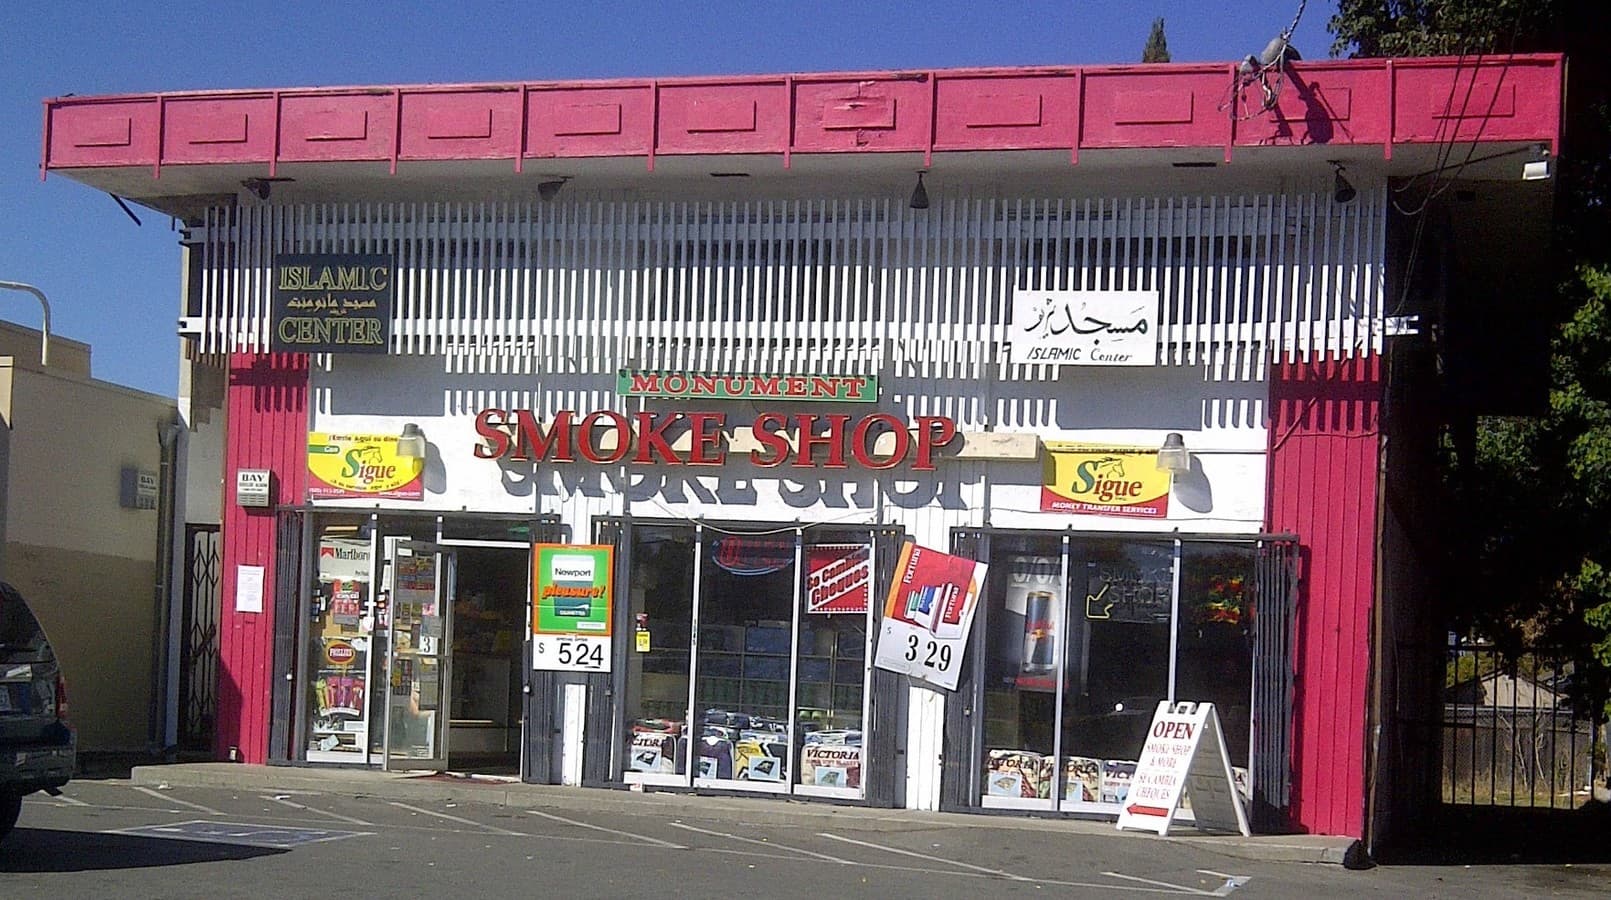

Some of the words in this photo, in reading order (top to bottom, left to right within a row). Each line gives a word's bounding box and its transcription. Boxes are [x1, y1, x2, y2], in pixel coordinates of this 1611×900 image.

[279, 266, 387, 291] ISLAMIC
[278, 316, 384, 344] CENTER
[1026, 347, 1082, 361] ISLAMIC
[1090, 348, 1133, 362] Center
[629, 373, 867, 398] MONUMENT
[473, 407, 728, 468] SMOKE
[750, 412, 957, 471] SHOP
[341, 448, 396, 485] Sigue
[1071, 459, 1143, 502] Sigue
[1052, 502, 1080, 510] MONEY
[1083, 503, 1121, 512] TRANSFER
[555, 567, 591, 577] Newport
[542, 584, 606, 600] pleasure!
[811, 565, 869, 606] Cheques
[1153, 721, 1196, 740] OPEN
[807, 749, 860, 760] VICTORIA
